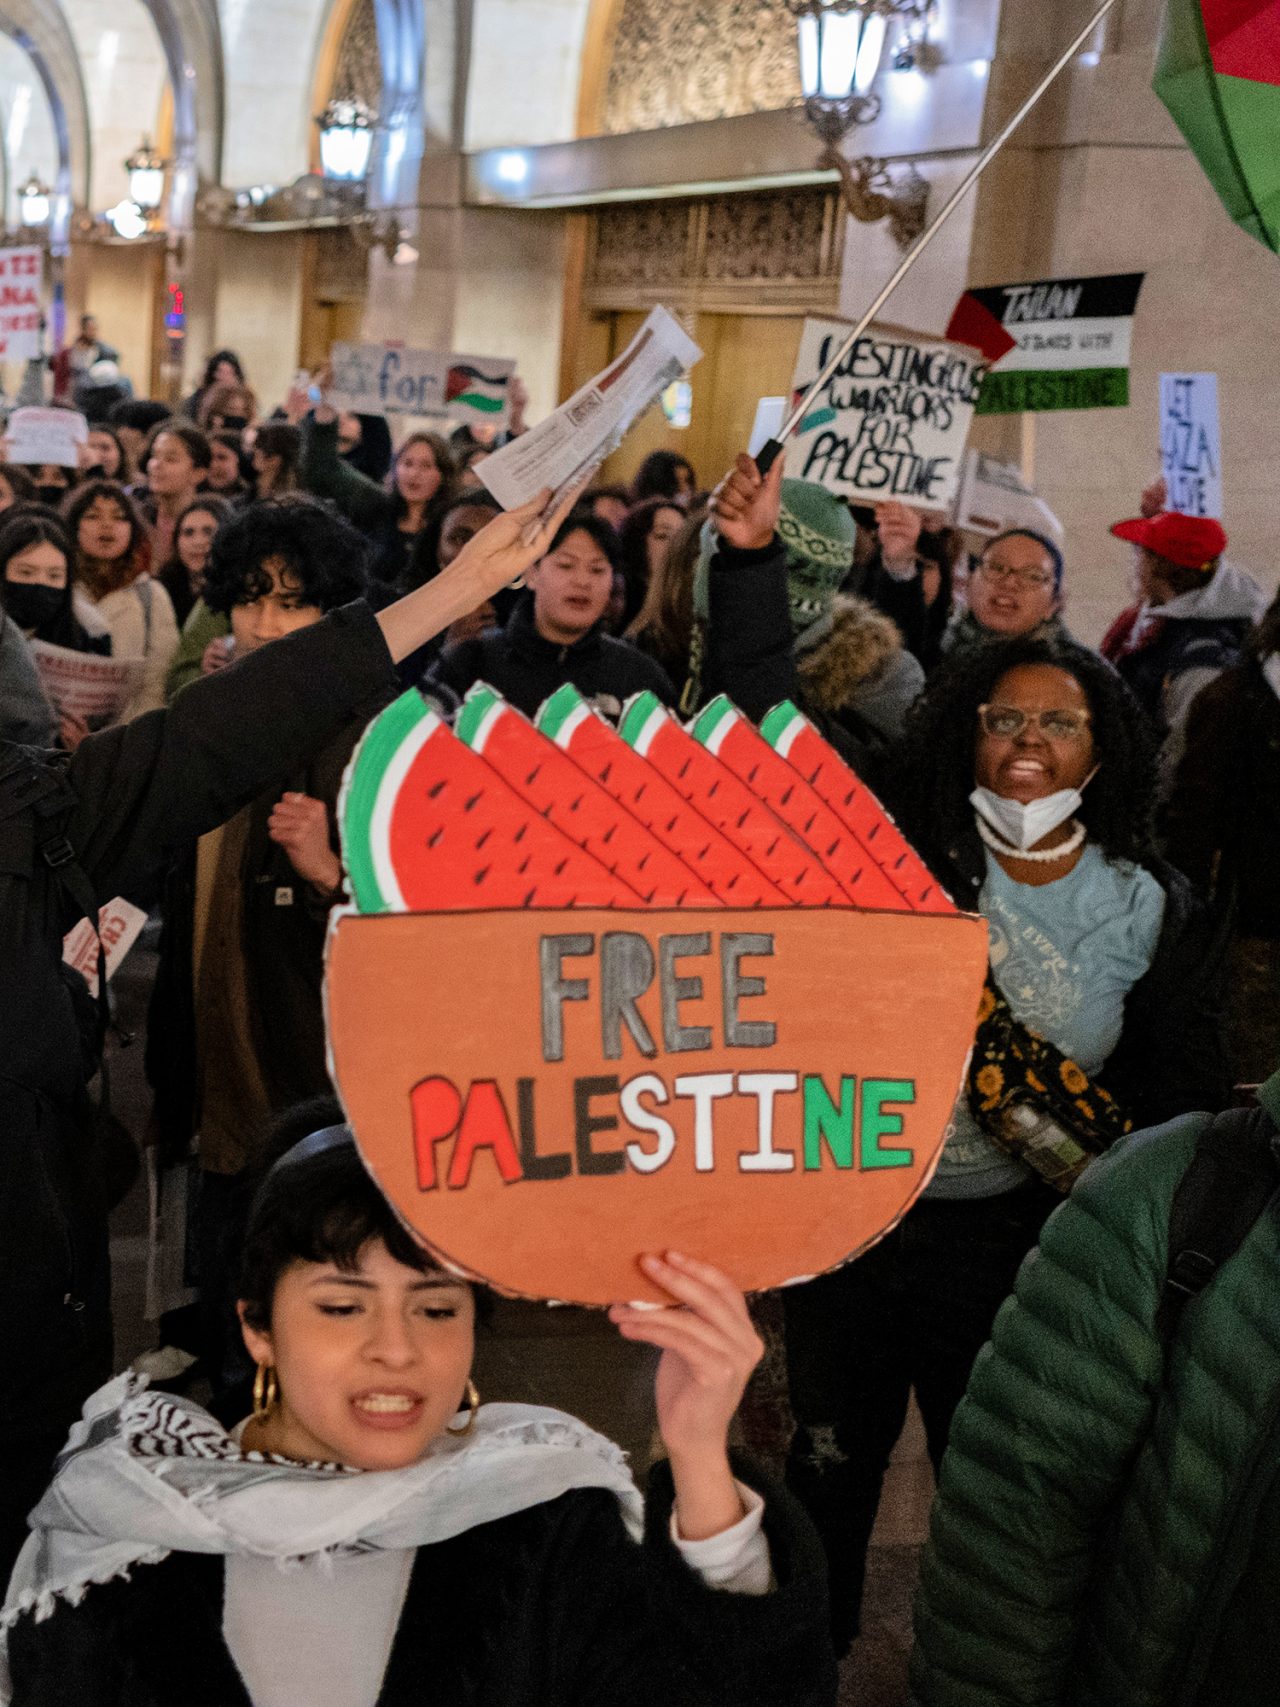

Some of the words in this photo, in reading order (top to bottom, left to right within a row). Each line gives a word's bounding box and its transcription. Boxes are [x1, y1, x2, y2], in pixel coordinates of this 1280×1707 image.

[379, 351, 438, 405] for
[802, 430, 953, 499] PALESTINE
[854, 414, 914, 454] FOR
[539, 931, 777, 1062] FREE
[408, 1071, 916, 1191] PALESTINE
